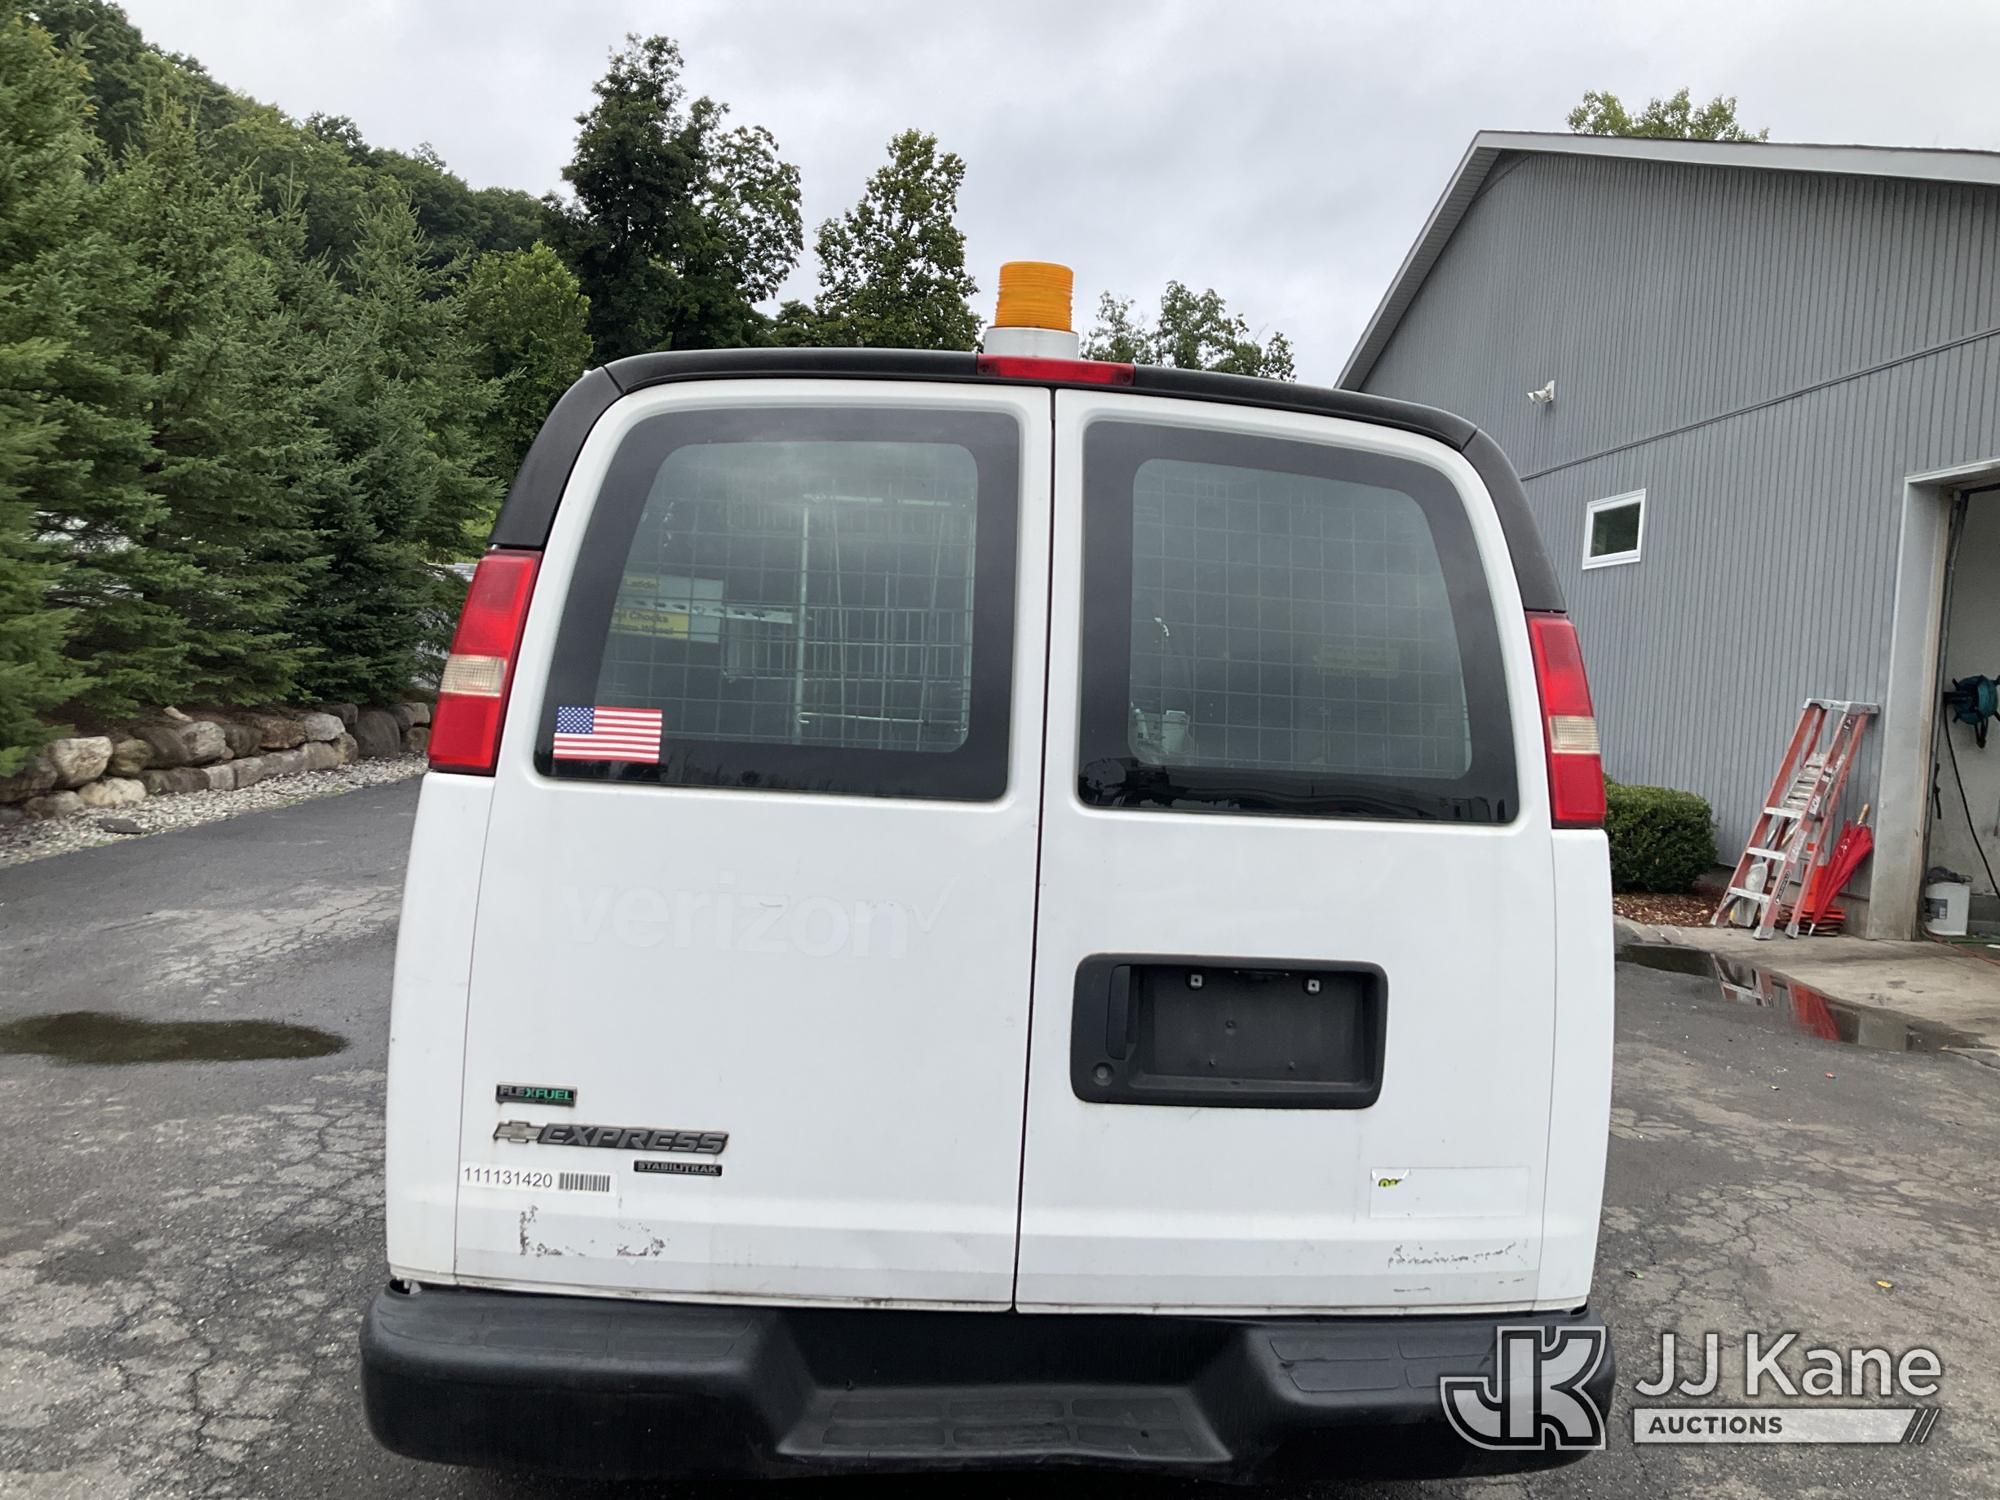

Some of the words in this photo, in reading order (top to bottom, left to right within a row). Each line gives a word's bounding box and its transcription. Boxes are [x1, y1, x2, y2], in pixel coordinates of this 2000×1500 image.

[560, 870, 909, 959] verizon
[499, 1084, 573, 1100] FLEXFUEL
[540, 1124, 729, 1154] EXPRESS
[464, 1167, 553, 1188] 111131420
[637, 1161, 718, 1174] STABILITRAK
